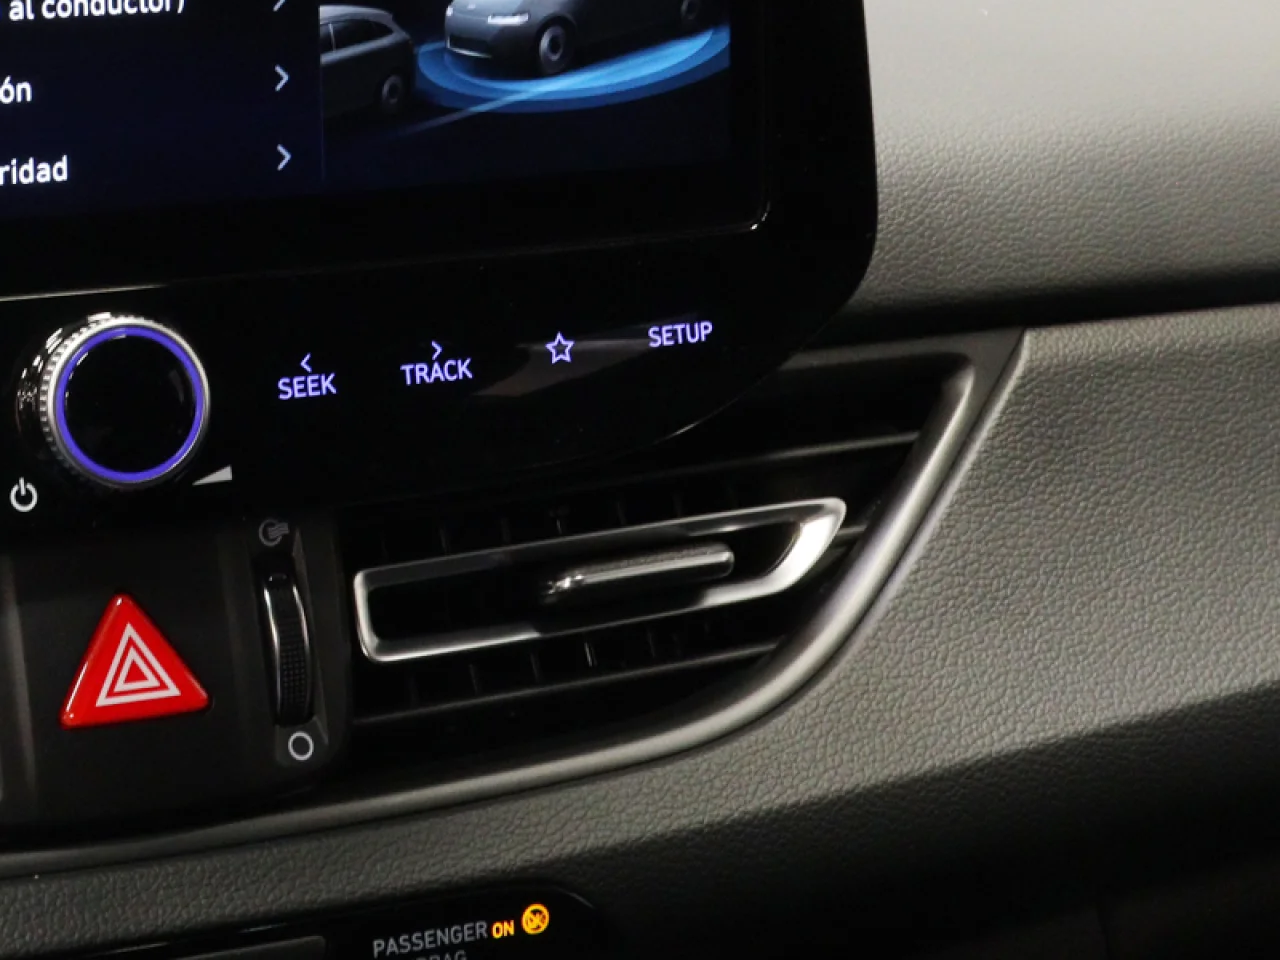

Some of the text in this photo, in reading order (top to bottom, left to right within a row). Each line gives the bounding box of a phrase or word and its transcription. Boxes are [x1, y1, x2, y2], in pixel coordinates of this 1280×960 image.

[647, 320, 714, 348] SETUP
[400, 358, 473, 386] TRACK
[277, 372, 338, 401] SEEK
[373, 919, 515, 958] PASSENGER ON
